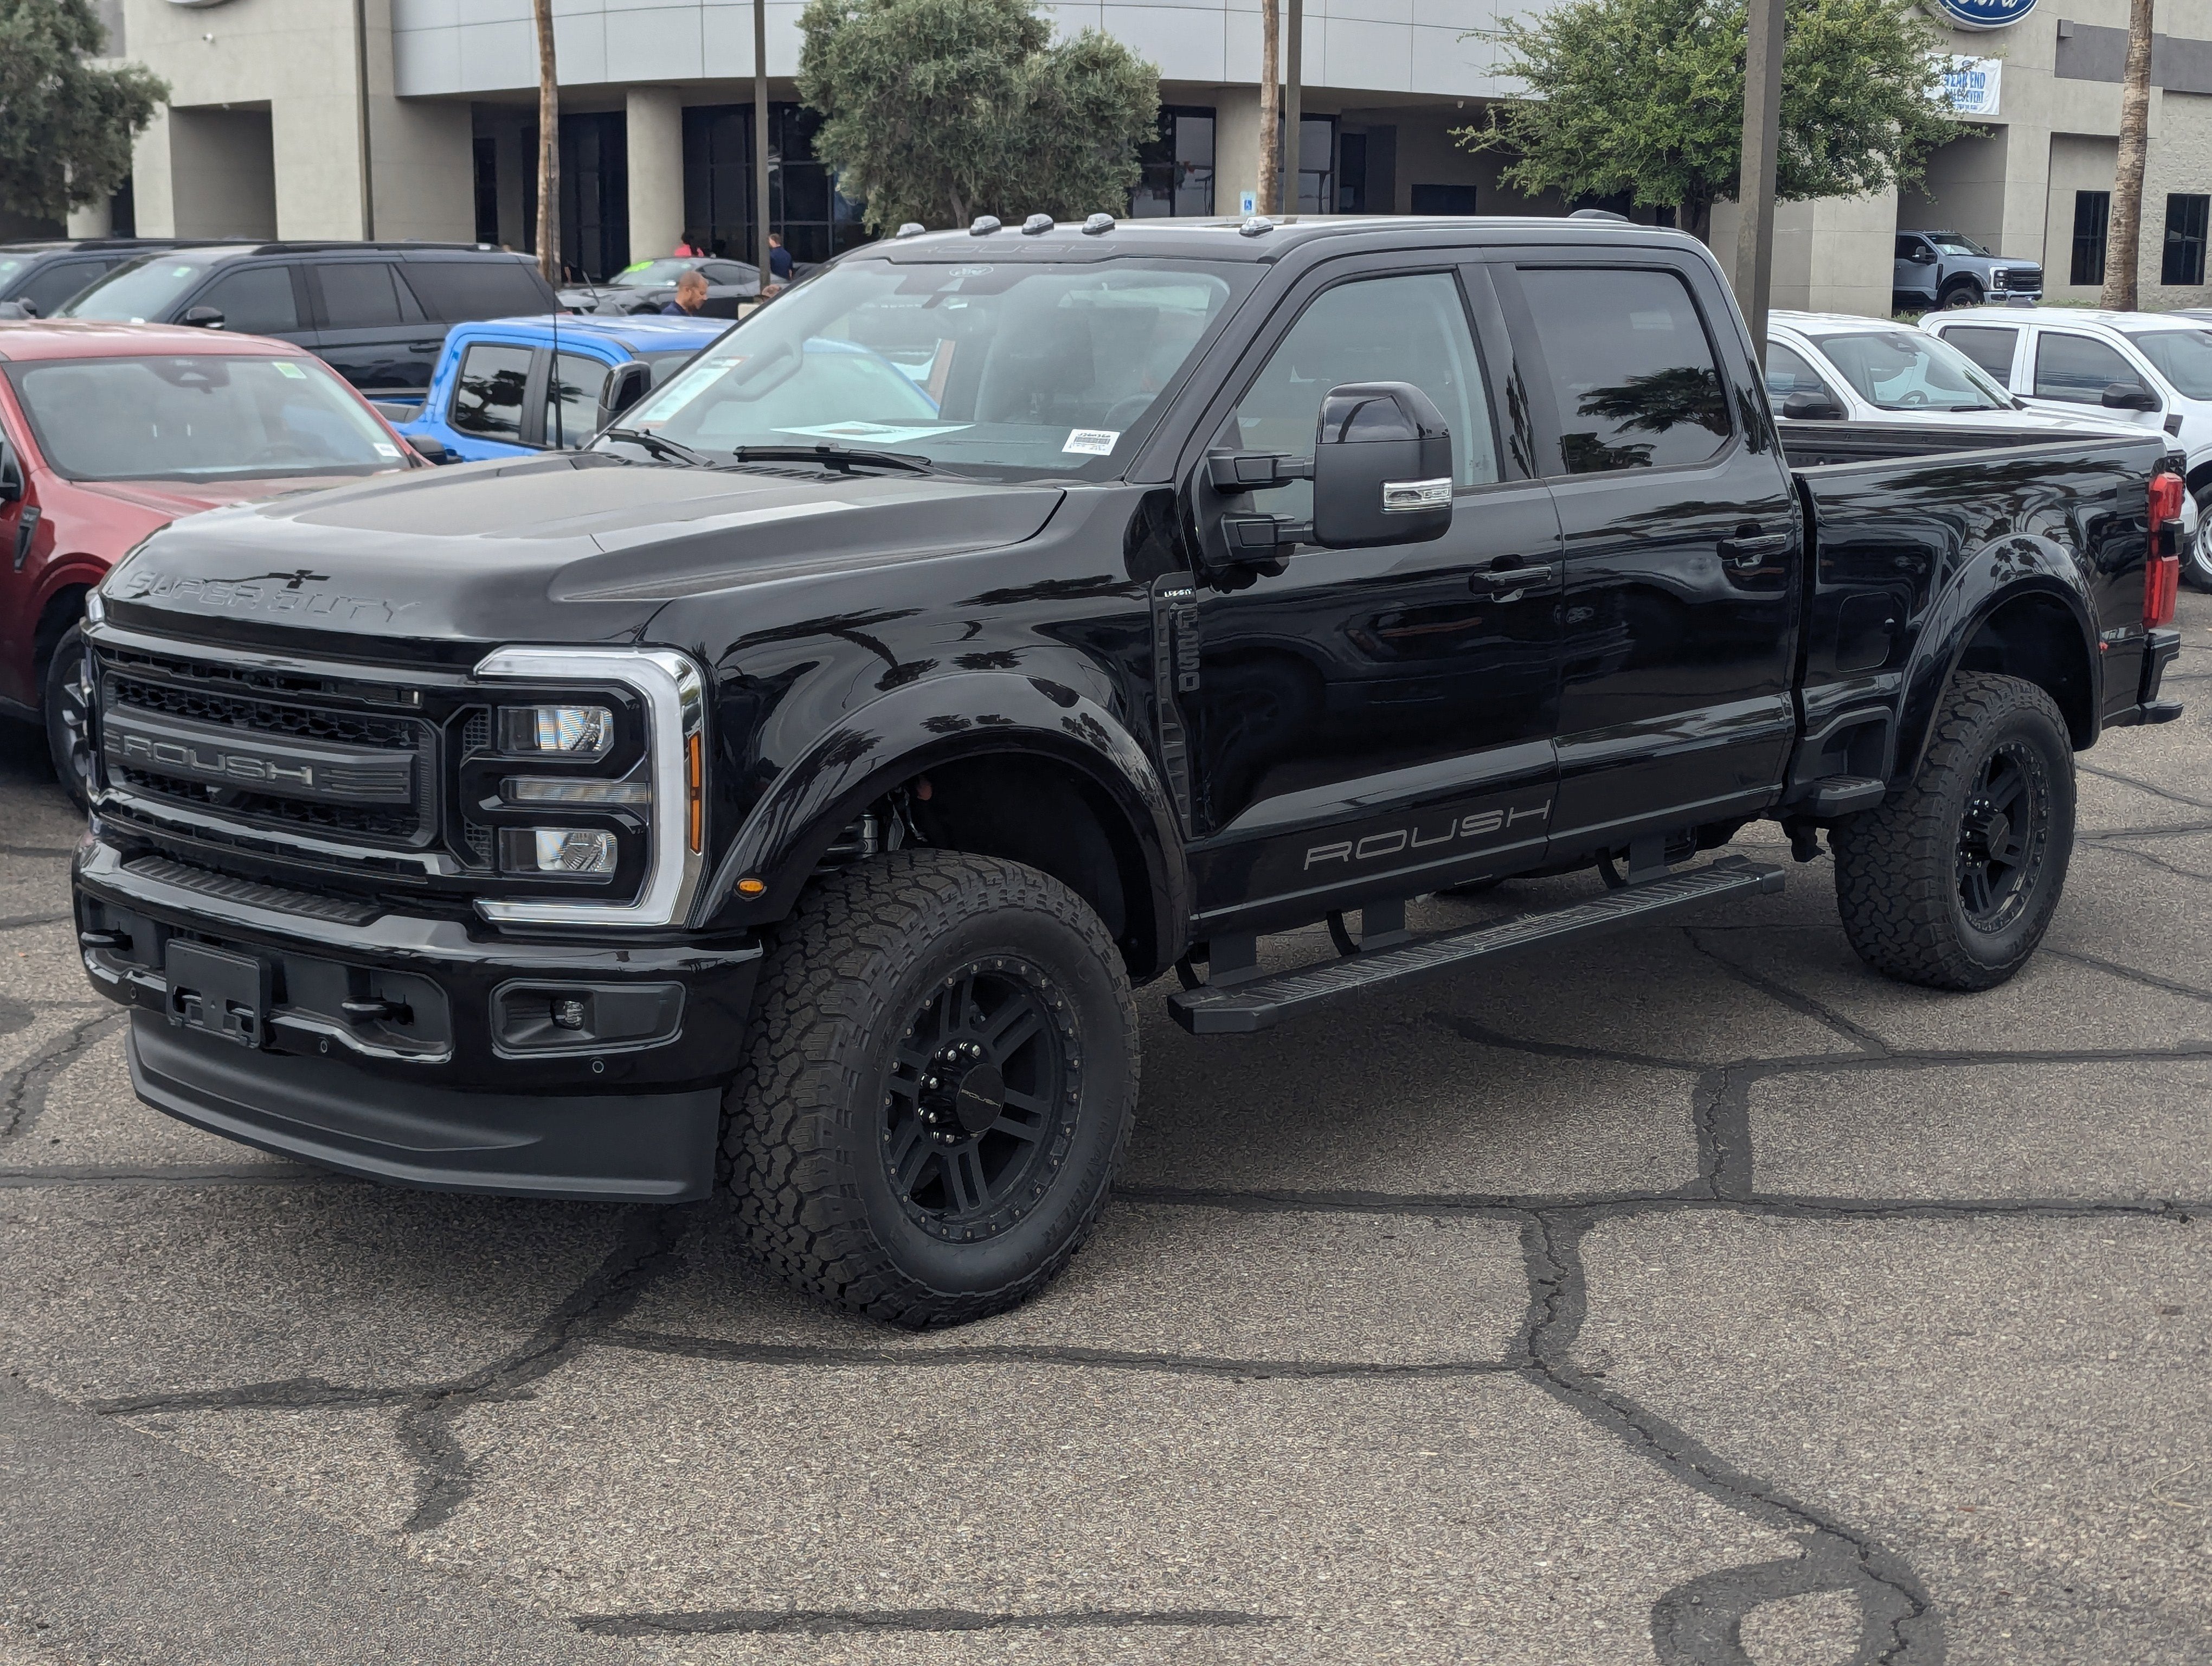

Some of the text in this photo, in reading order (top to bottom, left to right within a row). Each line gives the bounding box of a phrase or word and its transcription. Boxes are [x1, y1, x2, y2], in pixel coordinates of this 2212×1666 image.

[1969, 71, 1985, 89] END
[925, 245, 1116, 254] OUSH
[127, 569, 421, 623] SUPER DUTY
[123, 734, 314, 789] ROUSH
[1304, 799, 1551, 870] ROUSH
